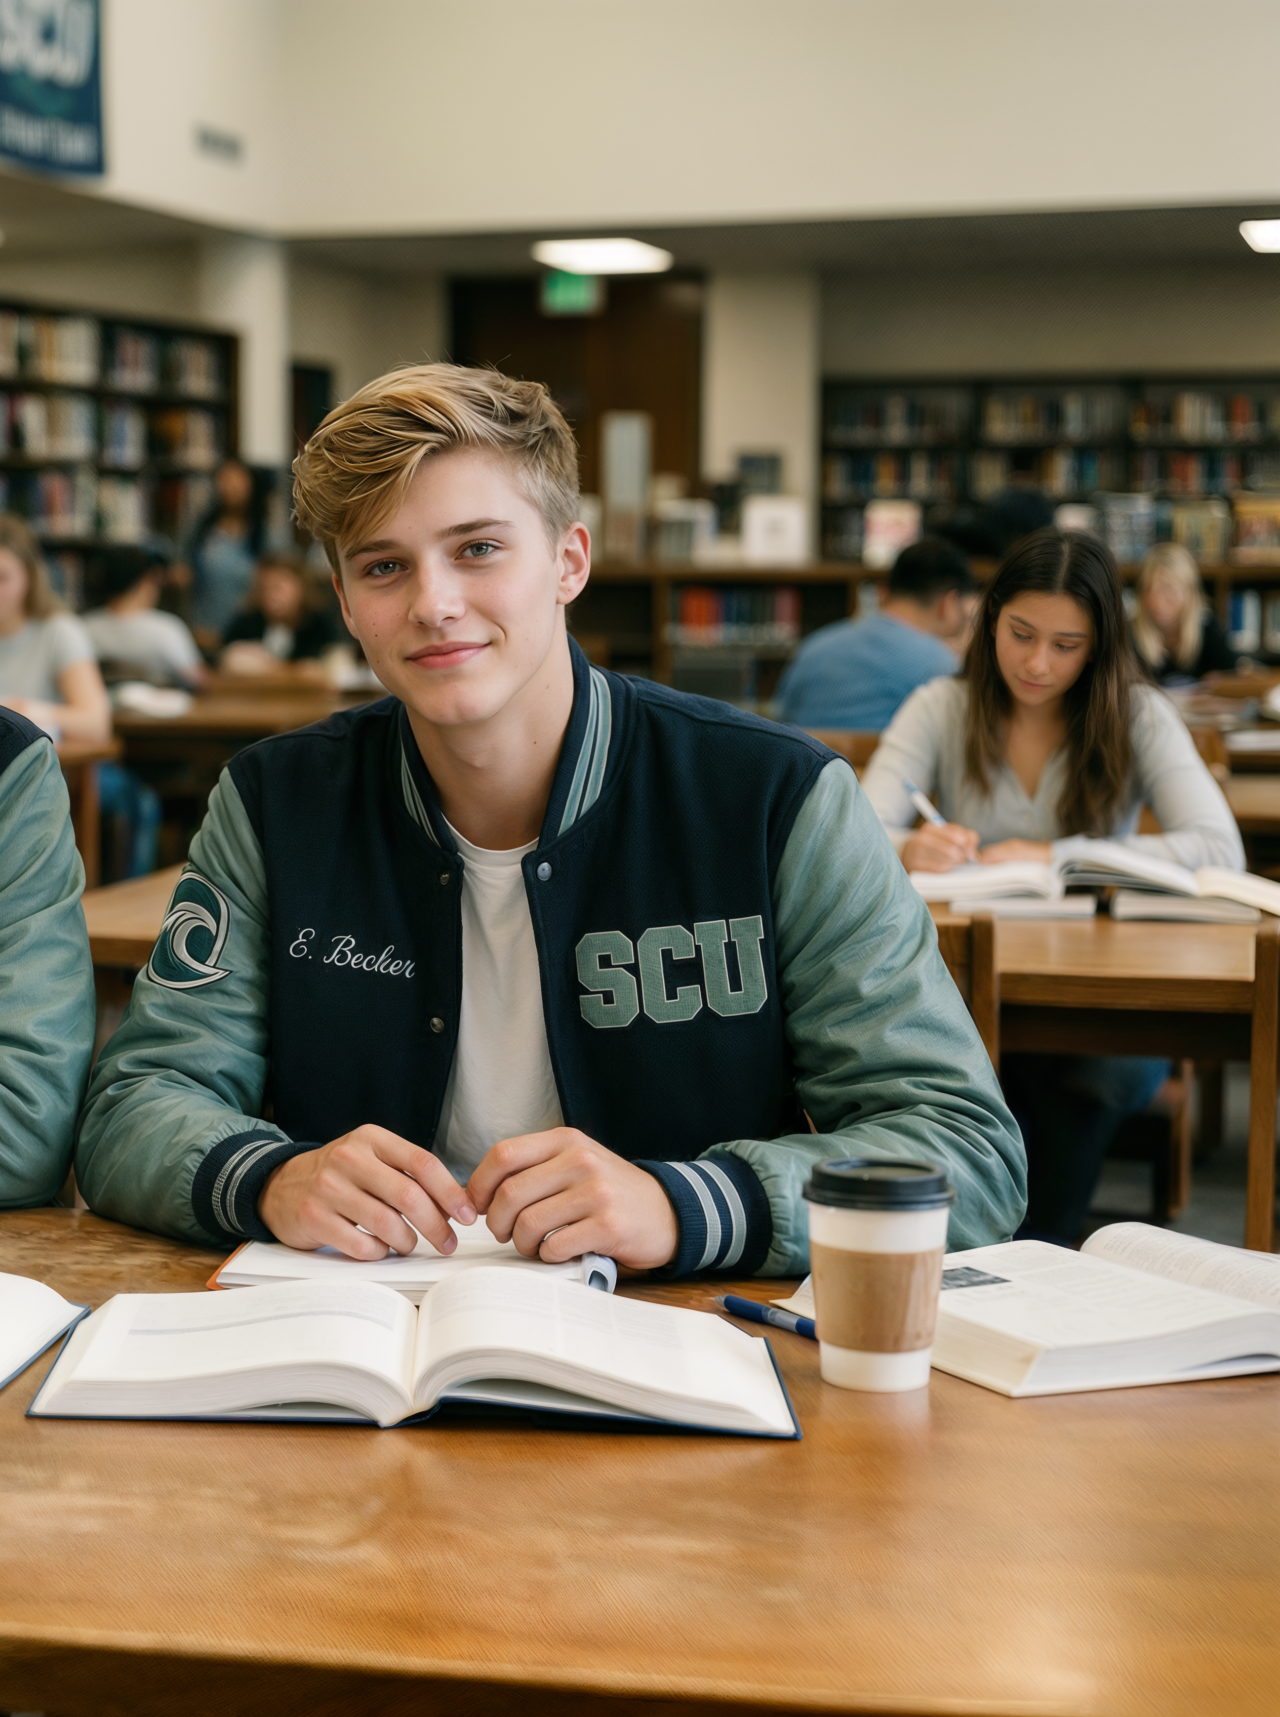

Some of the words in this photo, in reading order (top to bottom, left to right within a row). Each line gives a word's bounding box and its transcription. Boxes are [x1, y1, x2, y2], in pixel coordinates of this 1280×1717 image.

[289, 928, 316, 959] E.
[323, 934, 416, 979] Becker
[575, 914, 768, 1029] SCU
